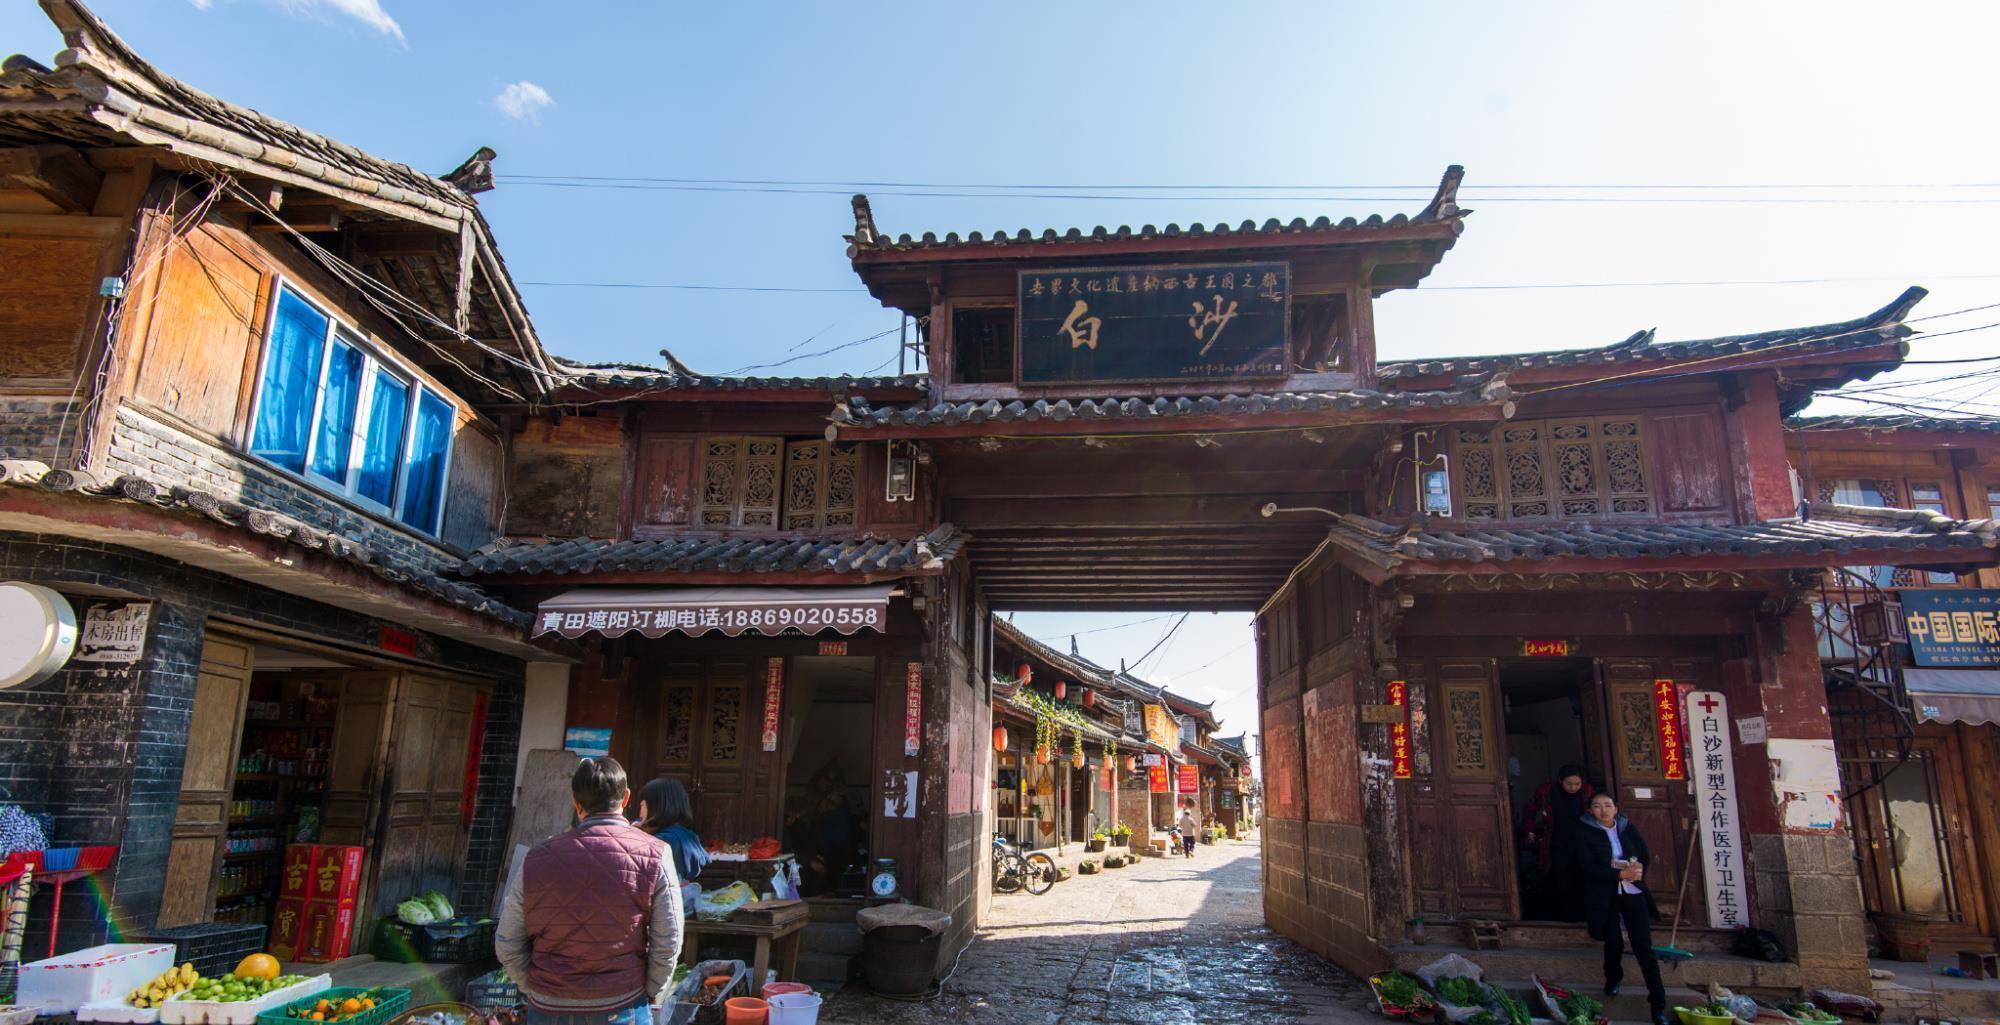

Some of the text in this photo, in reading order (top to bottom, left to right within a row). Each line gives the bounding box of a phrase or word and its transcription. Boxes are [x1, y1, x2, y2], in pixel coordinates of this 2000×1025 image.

[1056, 294, 1238, 357] 白沙
[1907, 610, 2000, 644] 中国国际
[1702, 716, 1740, 927] 白沙新型合作医疗卫生室
